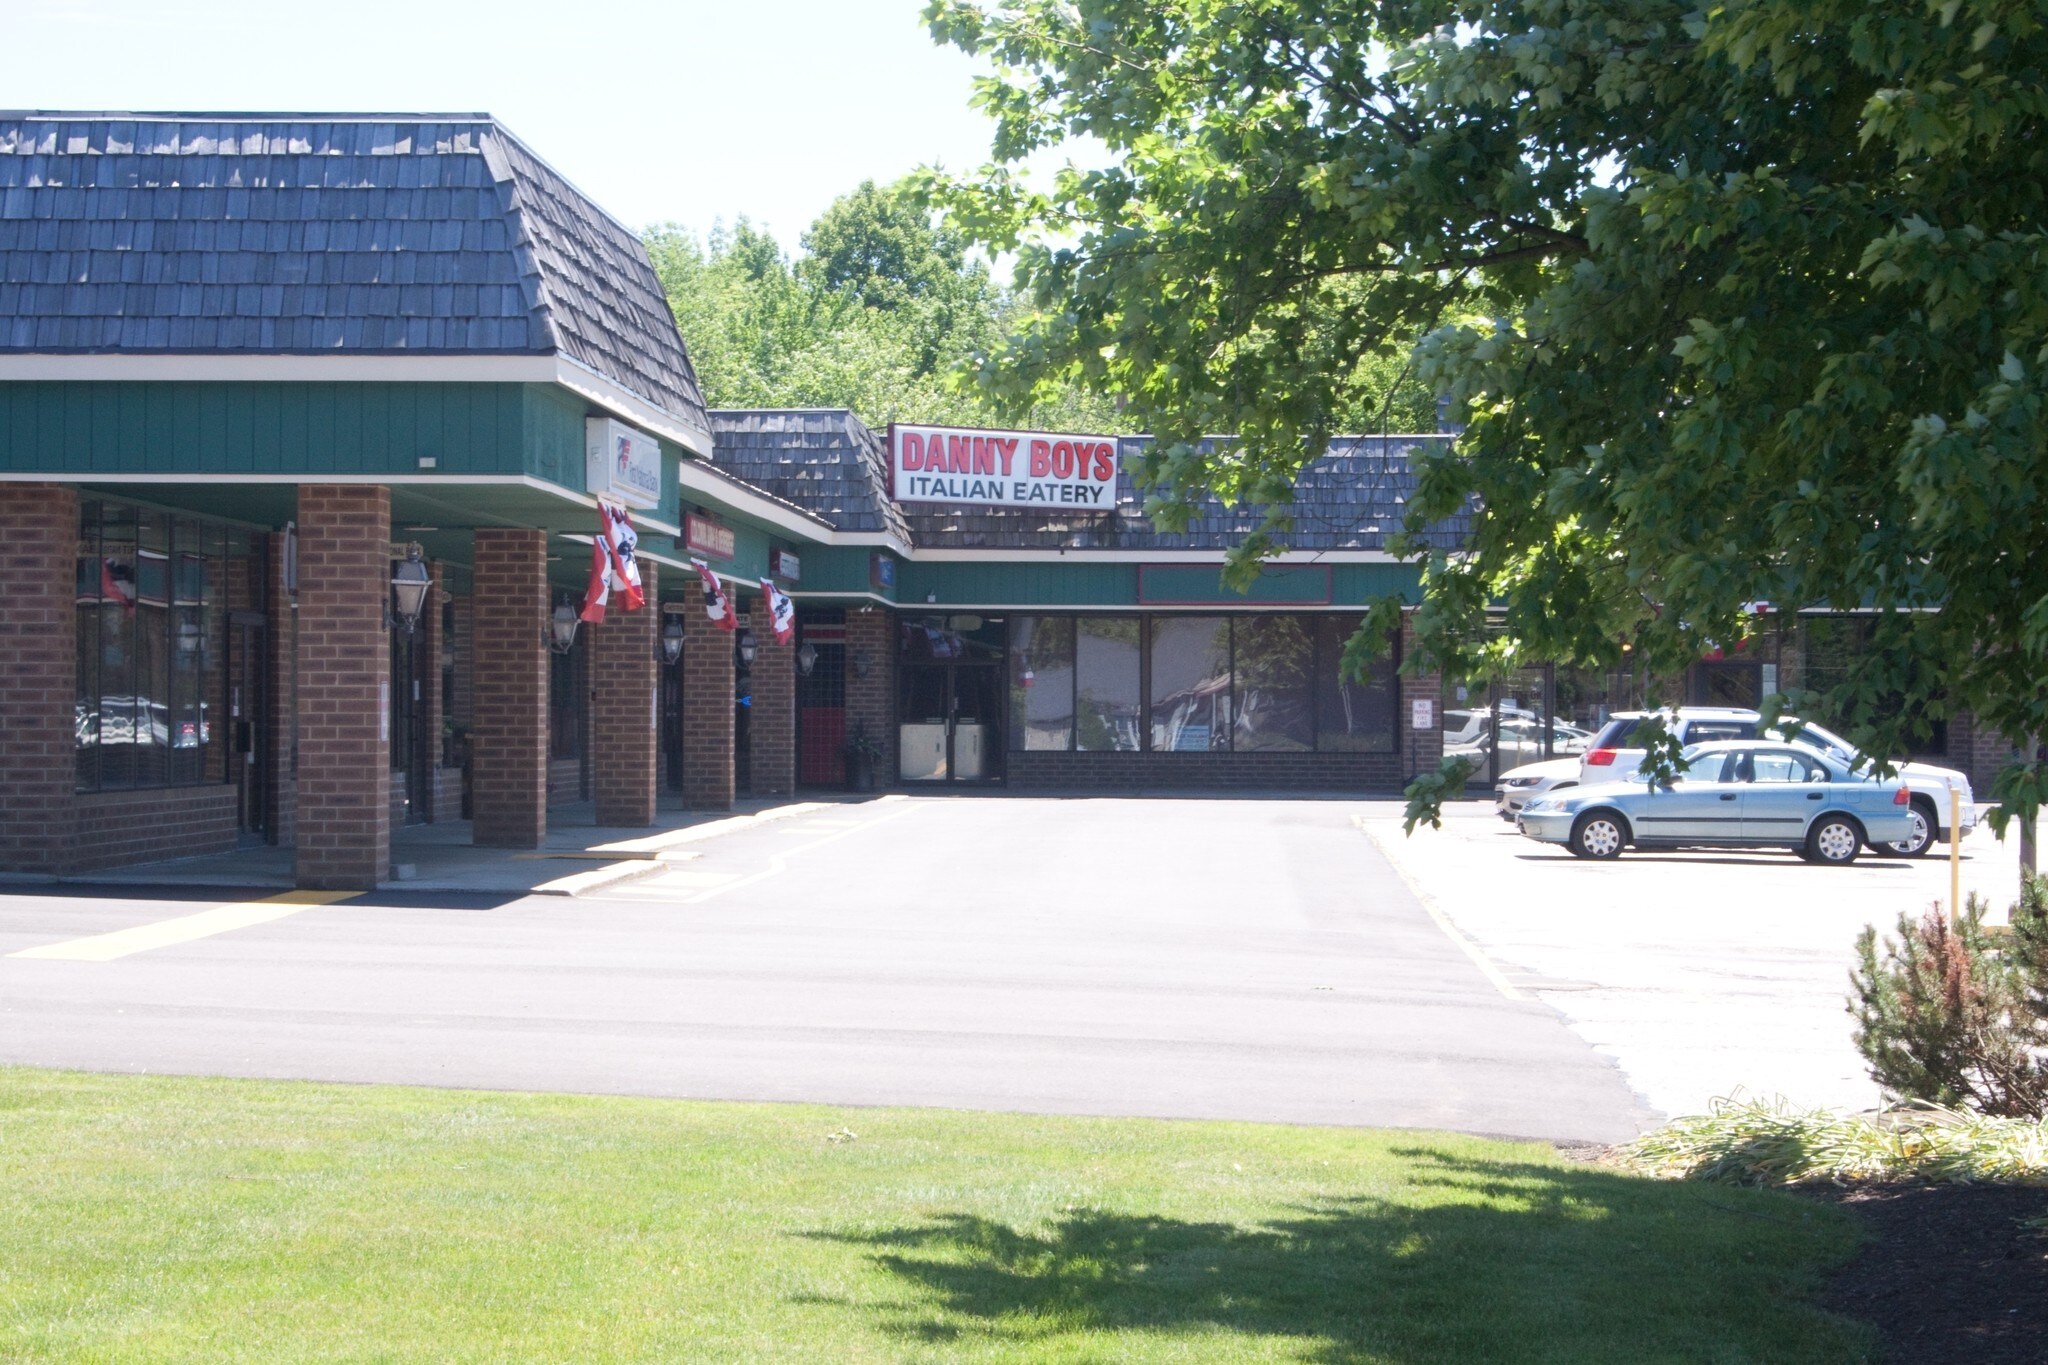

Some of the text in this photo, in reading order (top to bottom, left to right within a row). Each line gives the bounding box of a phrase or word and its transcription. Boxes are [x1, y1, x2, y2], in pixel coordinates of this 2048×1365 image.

[902, 432, 1114, 482] DANNY BOYS
[909, 476, 1104, 504] ITALIAN EATERY
